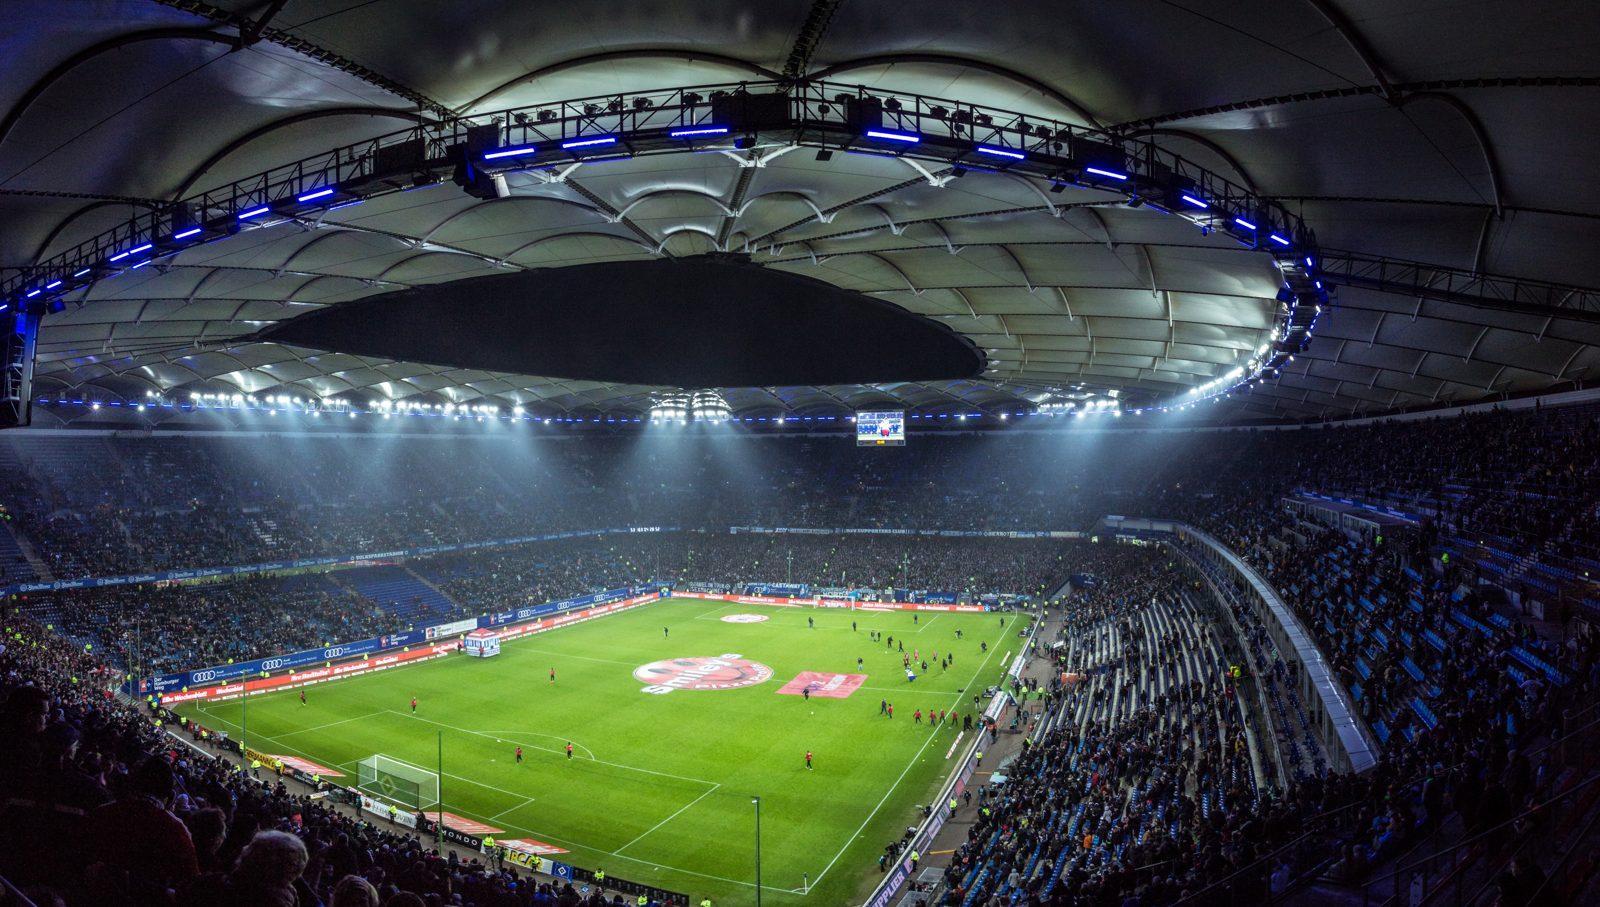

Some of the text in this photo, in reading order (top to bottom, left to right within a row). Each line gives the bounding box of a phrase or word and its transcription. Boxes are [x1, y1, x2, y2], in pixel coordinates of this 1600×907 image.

[355, 551, 404, 561] VOLKSPARKSTADION
[154, 678, 179, 686] Hamburger
[162, 691, 208, 704] Elbe Wochenblatt
